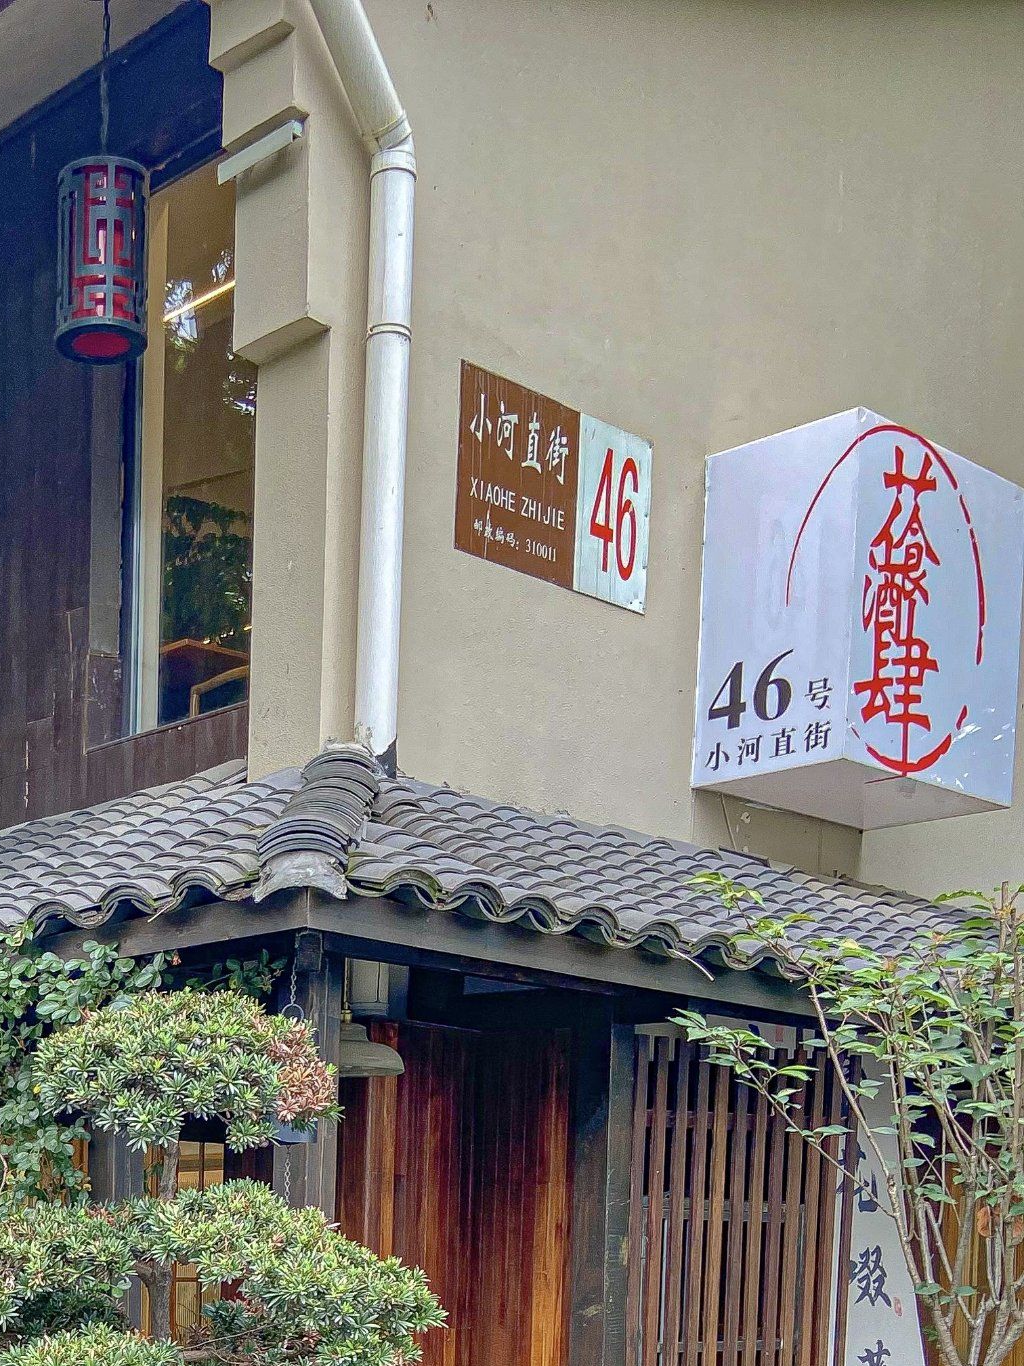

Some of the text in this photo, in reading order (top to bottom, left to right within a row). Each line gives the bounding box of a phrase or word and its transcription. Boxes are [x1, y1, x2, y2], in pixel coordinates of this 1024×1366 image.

[469, 393, 569, 485] 小河直街
[470, 477, 565, 531] XIAOHE ZHIJIE
[590, 448, 639, 581] 46
[525, 538, 556, 562] 310011
[705, 720, 832, 771] 小河直街
